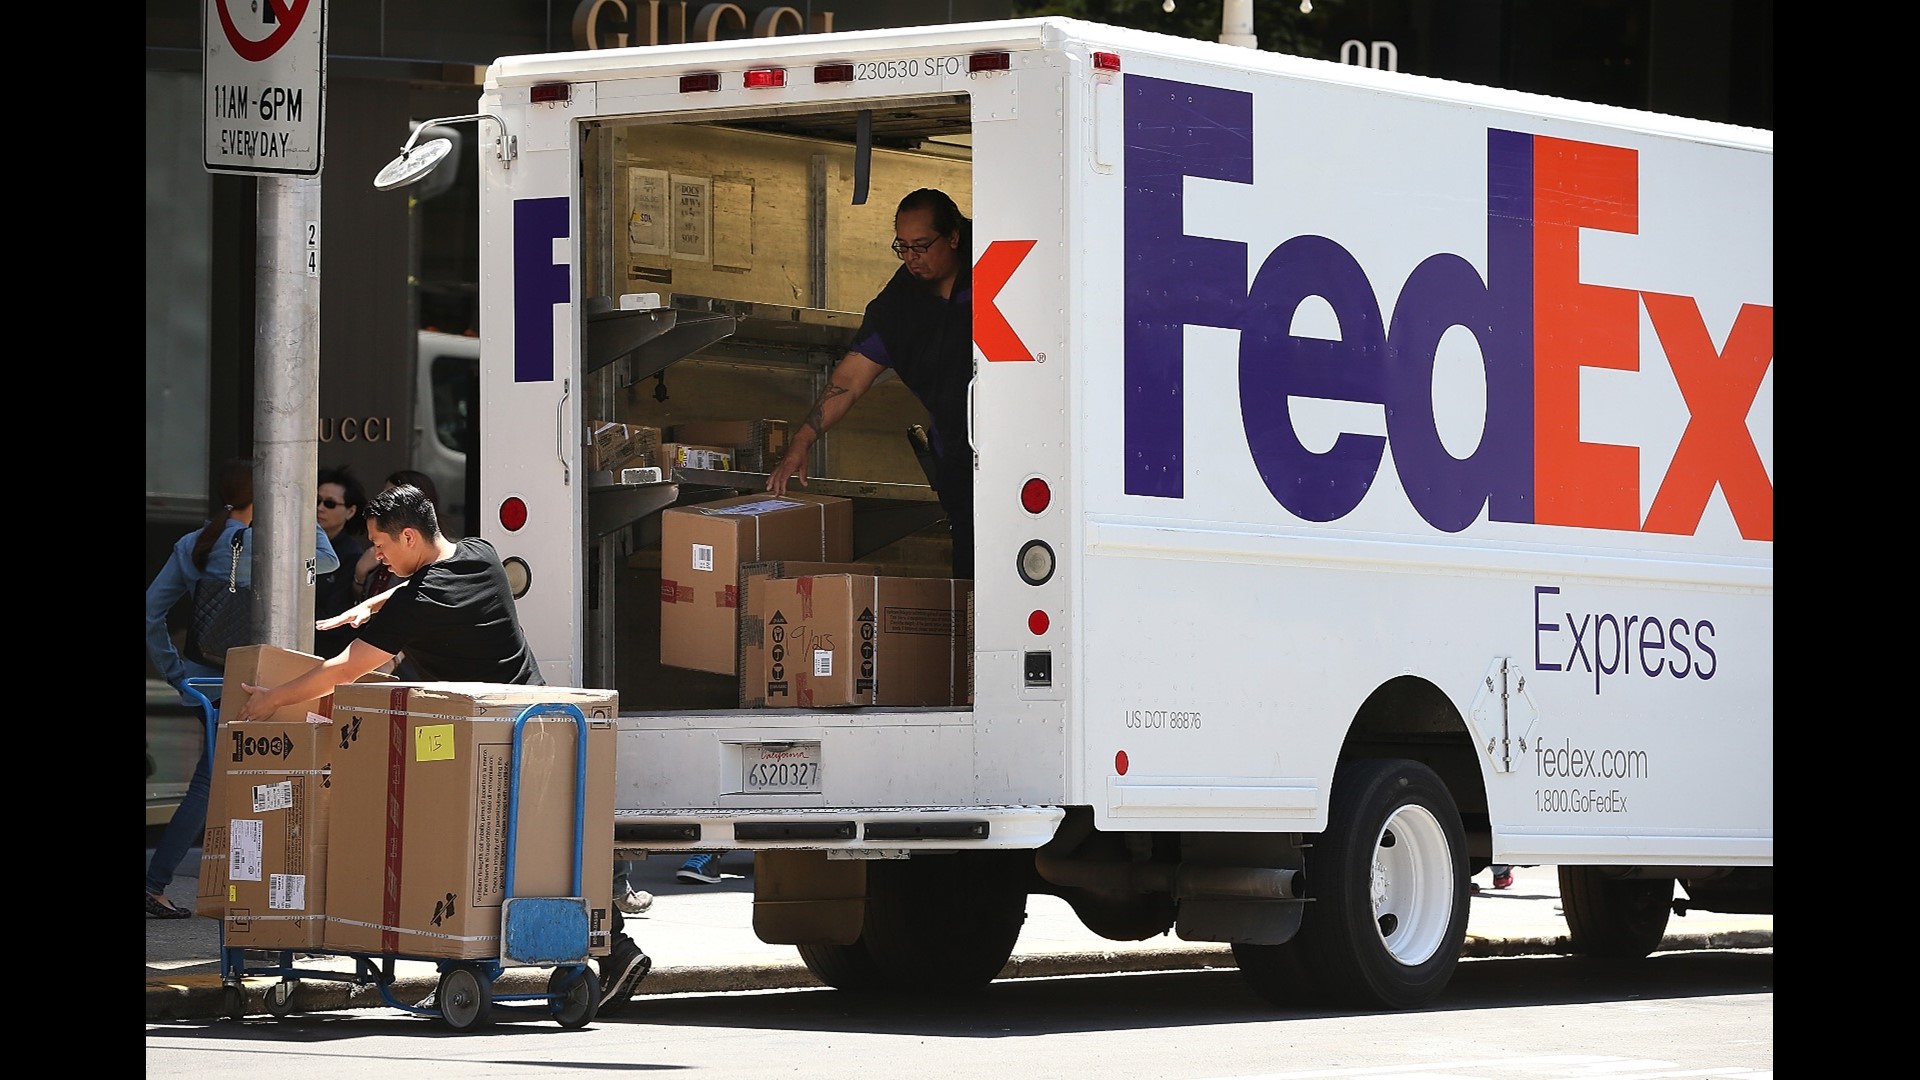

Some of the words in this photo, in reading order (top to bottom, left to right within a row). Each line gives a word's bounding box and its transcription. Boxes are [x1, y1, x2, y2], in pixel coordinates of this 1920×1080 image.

[854, 60, 918, 80] 230530
[924, 57, 959, 76] SFO
[222, 130, 289, 158] EVERYDAY
[1124, 73, 1773, 541] FedEx
[320, 417, 391, 443] UCCI
[1535, 586, 1717, 695] Express
[1126, 711, 1141, 728] US
[1145, 711, 1167, 728] DOT
[761, 748, 809, 762] California
[1535, 737, 1648, 778] fedex.com
[749, 763, 818, 786] 6S20327
[1535, 789, 1627, 813] 1.800.GoFedEx
